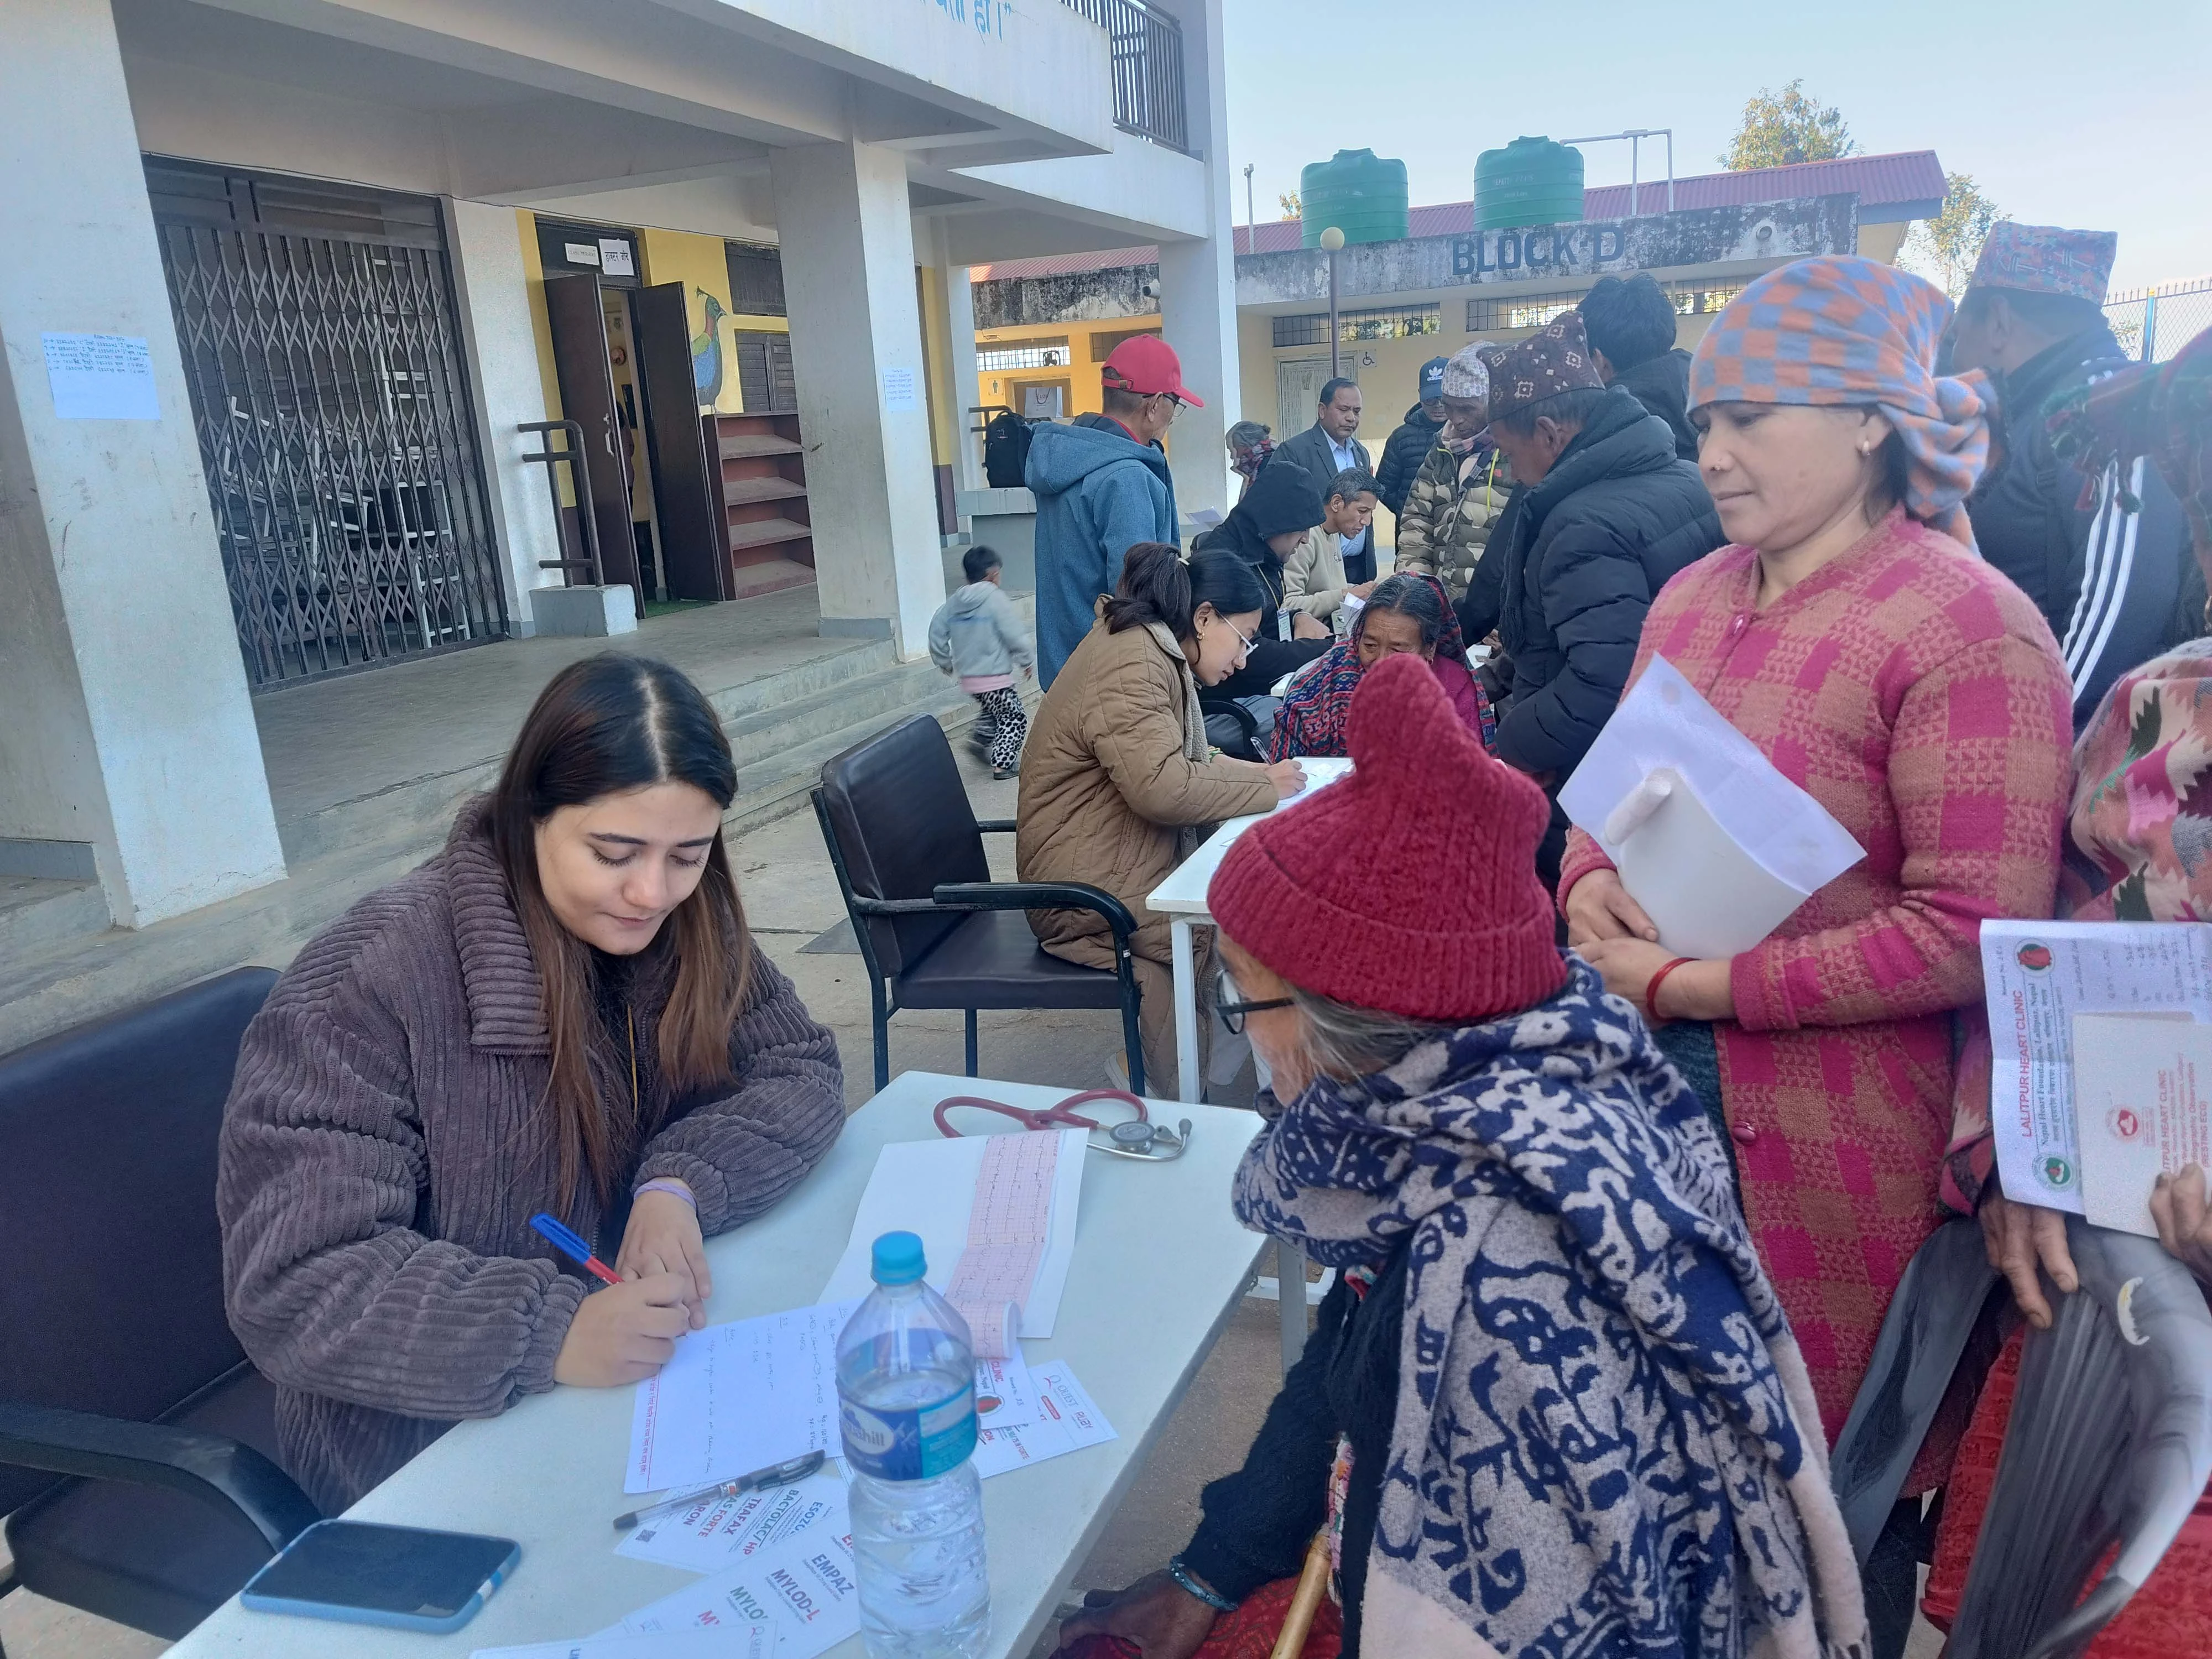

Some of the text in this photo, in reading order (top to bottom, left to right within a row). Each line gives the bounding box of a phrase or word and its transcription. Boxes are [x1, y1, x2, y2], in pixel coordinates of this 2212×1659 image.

[2013, 989, 2032, 1138] LALITPUR HEART CLINIC
[2158, 1068, 2168, 1102] CLINIC
[2038, 1097, 2046, 1120] Heart
[2160, 1104, 2169, 1138] HEART
[990, 1360, 1004, 1383] CLINIC
[1057, 1384, 1079, 1408] QUEST
[1074, 1411, 1093, 1429] RUBY
[697, 1509, 728, 1538] FORTE
[724, 1498, 763, 1536] TRAFAX
[811, 1553, 855, 1595] EMPAZ
[729, 1585, 769, 1620] MYLO
[770, 1568, 821, 1621] MYLOD-L
